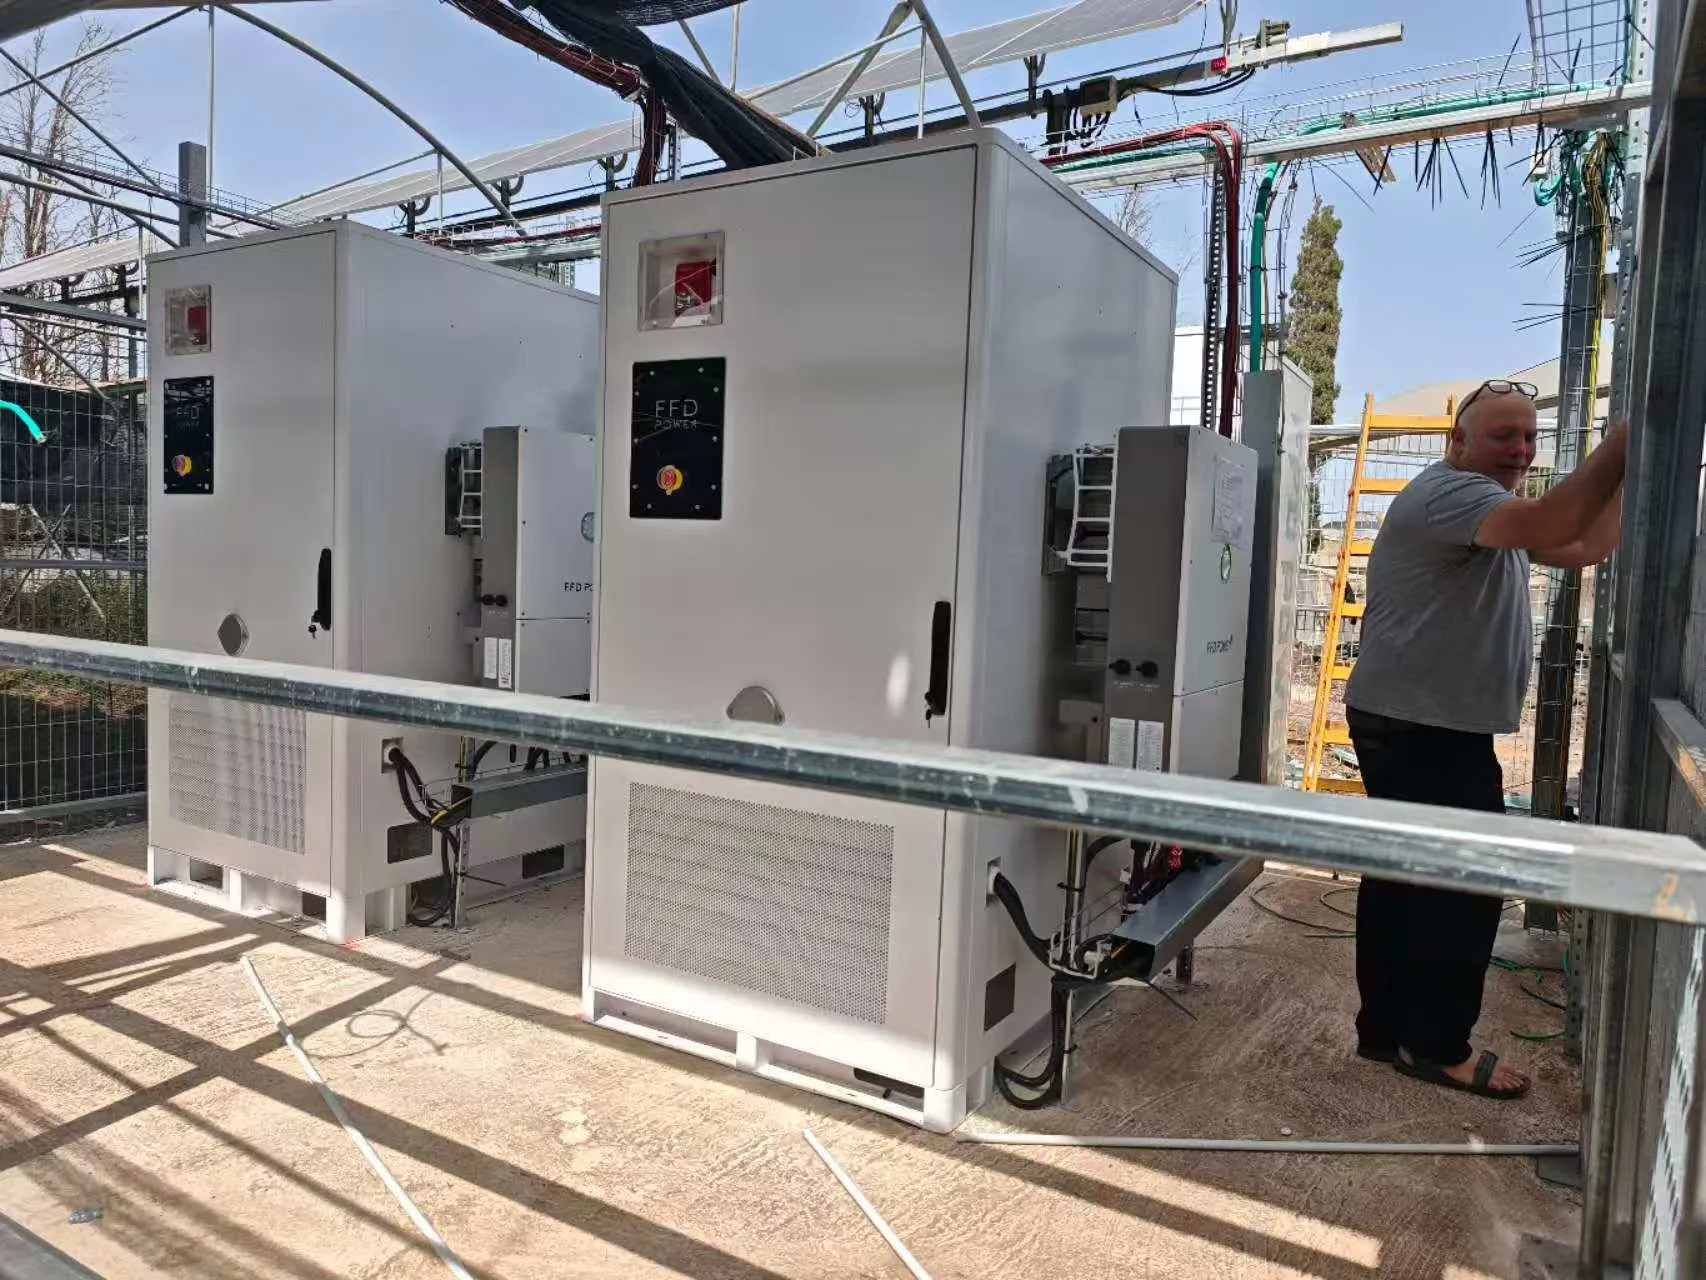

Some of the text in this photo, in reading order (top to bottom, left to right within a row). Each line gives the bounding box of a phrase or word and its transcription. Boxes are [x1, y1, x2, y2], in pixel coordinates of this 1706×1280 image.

[655, 399, 698, 417] FFD
[655, 418, 697, 430] POWER
[564, 582, 582, 592] FFD
